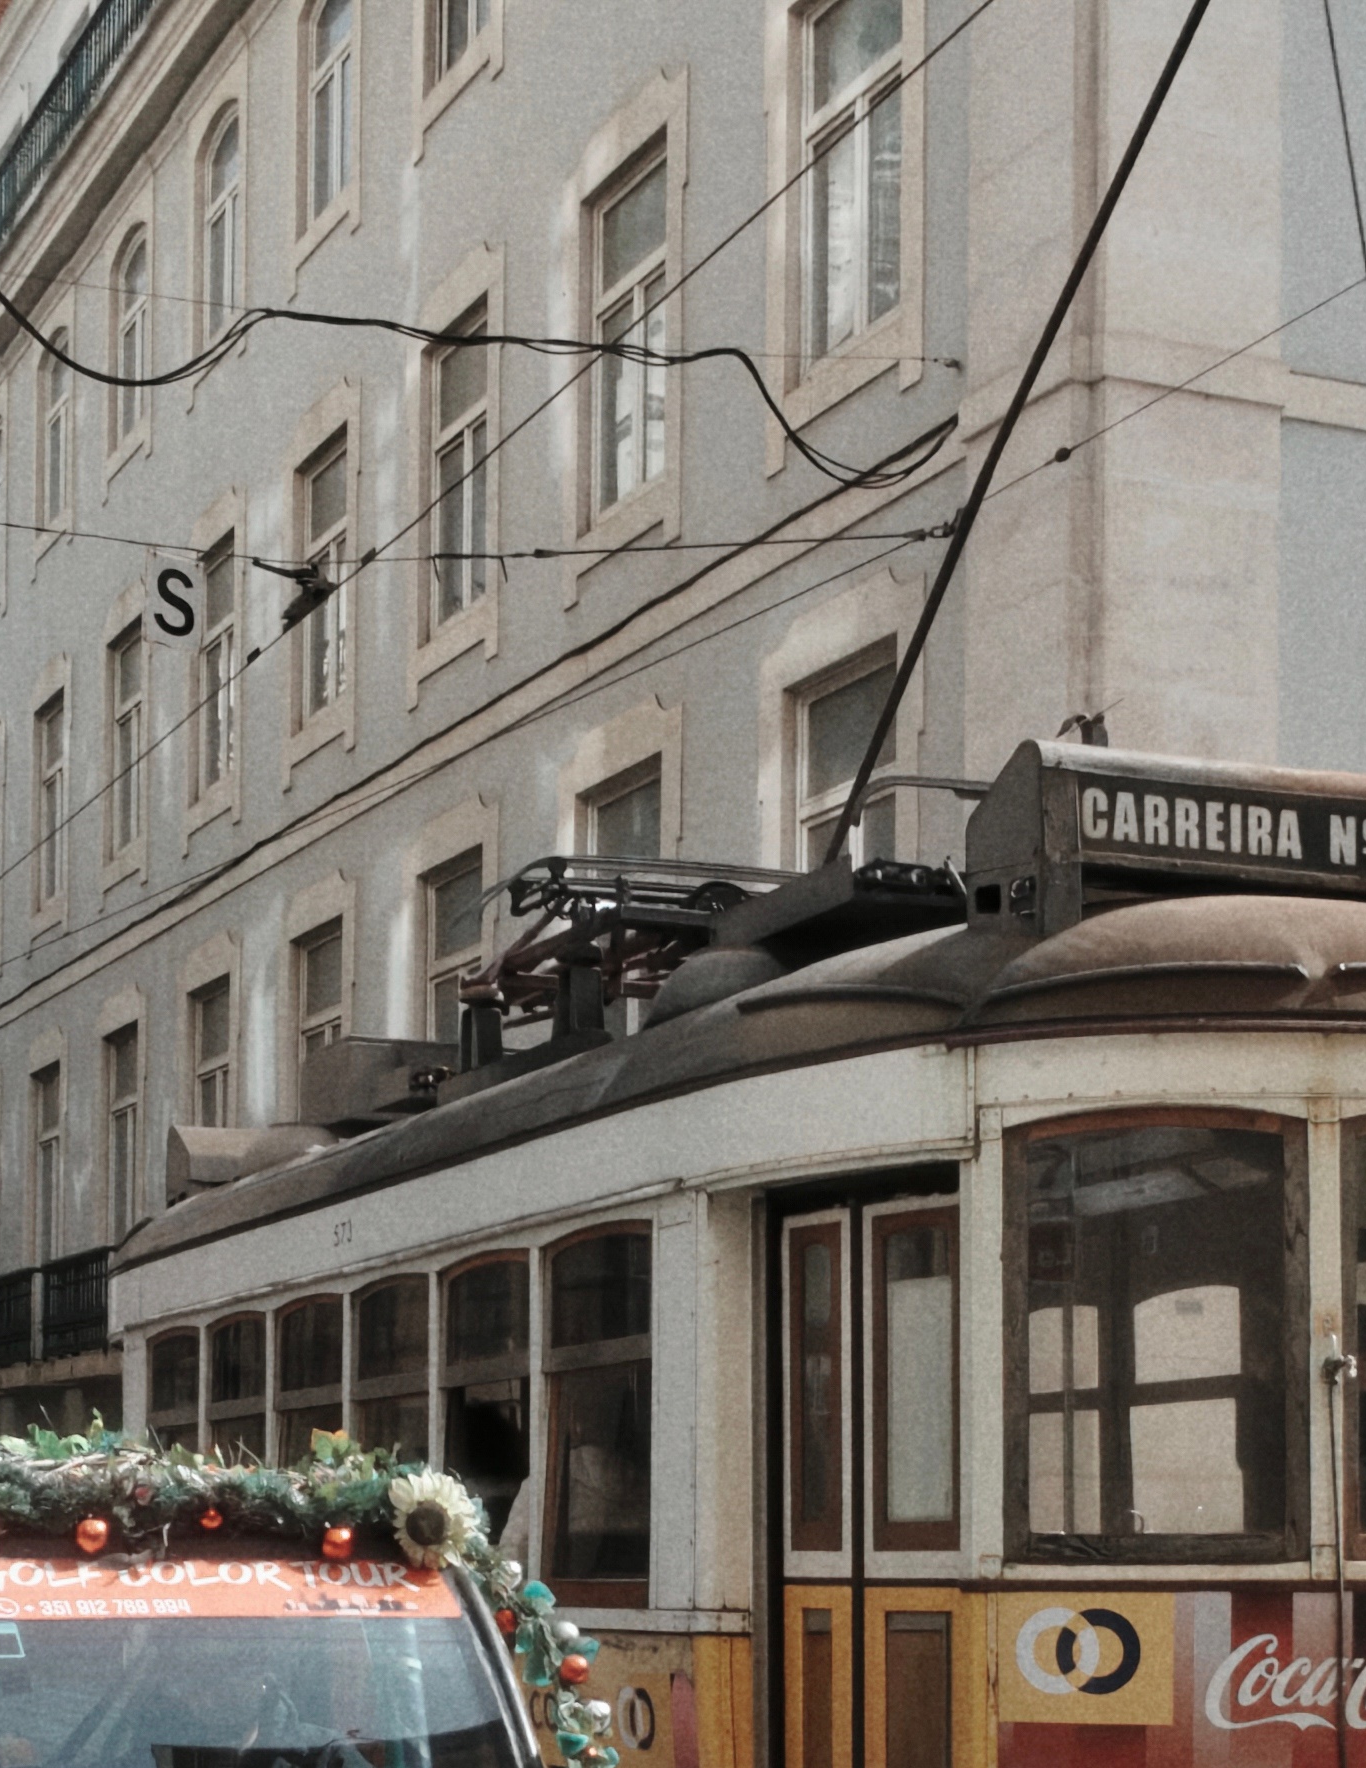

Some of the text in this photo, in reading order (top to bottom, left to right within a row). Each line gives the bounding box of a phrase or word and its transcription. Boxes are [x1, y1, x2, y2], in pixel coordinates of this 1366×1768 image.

[154, 568, 194, 636] S
[1082, 787, 1303, 860] CARREIRA
[119, 1560, 292, 1591] COLOR
[289, 1561, 420, 1591] TOUR
